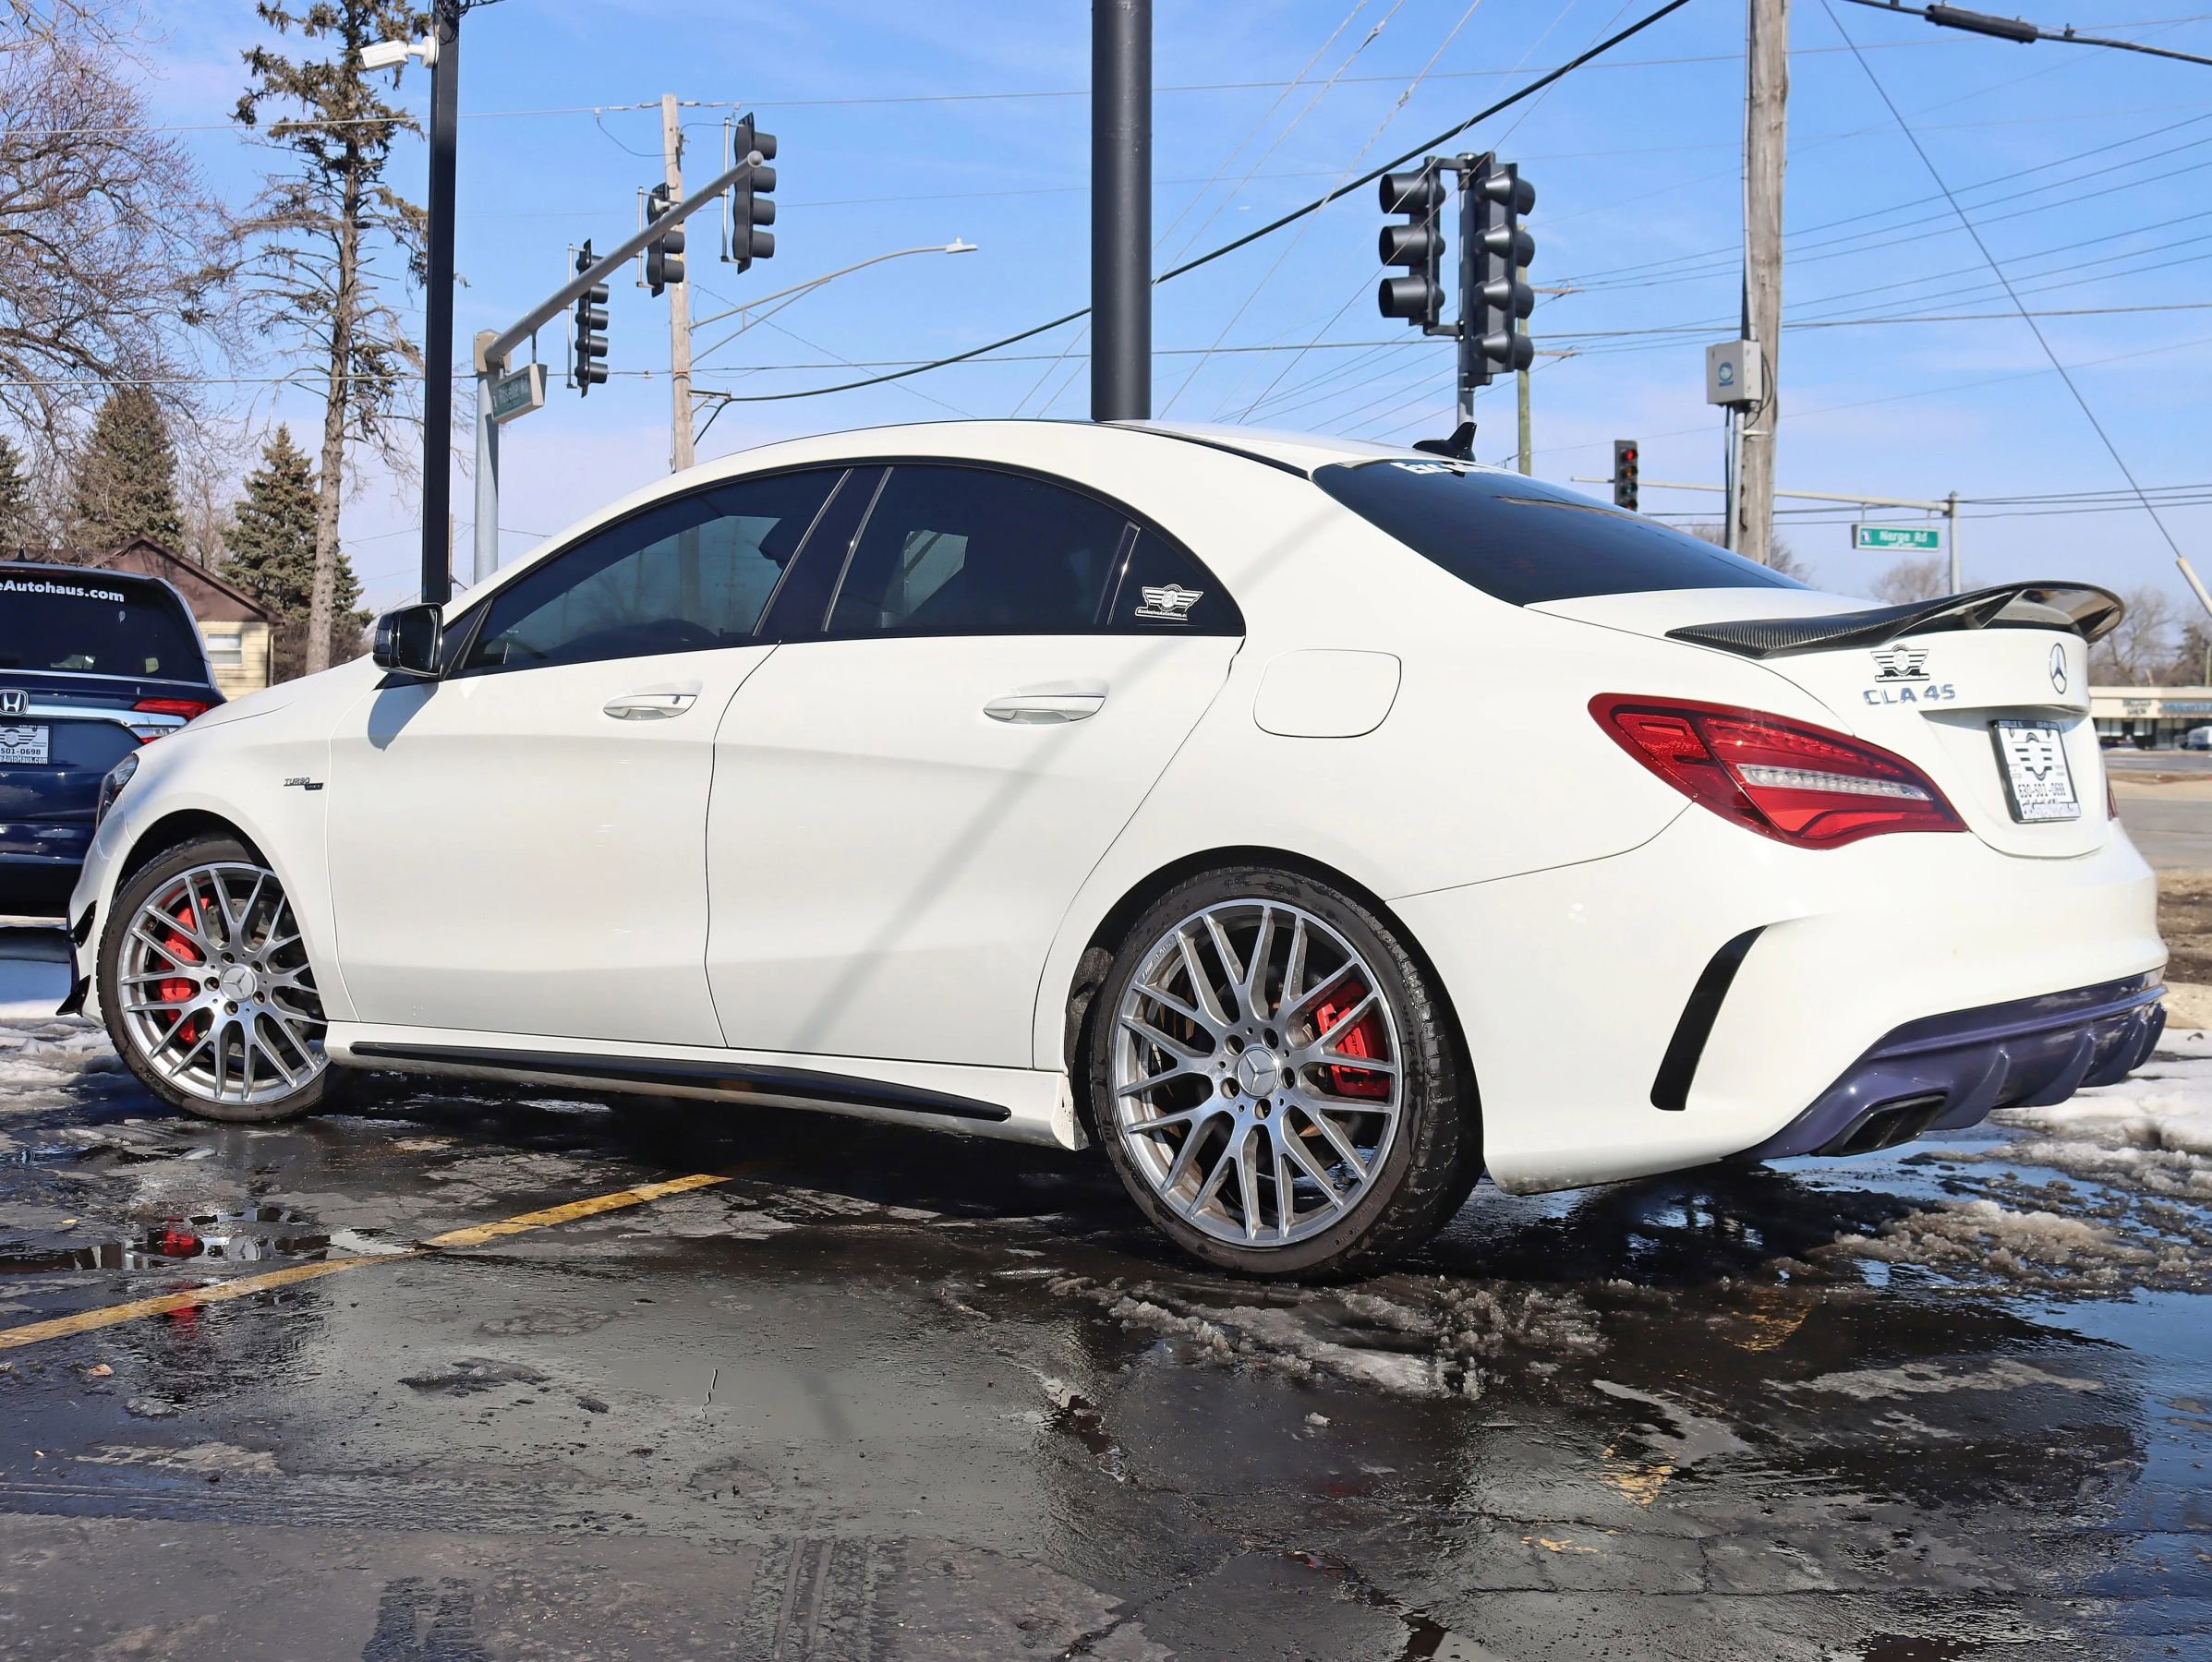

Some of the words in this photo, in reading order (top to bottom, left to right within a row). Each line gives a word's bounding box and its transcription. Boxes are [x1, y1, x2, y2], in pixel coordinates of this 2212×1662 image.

[1879, 531, 1911, 544] Nerge
[1914, 532, 1928, 543] Rd
[0, 580, 125, 603] Autohaus.com
[1863, 687, 1917, 705] CLA
[1923, 683, 1956, 701] 45
[284, 777, 311, 785] TURBO
